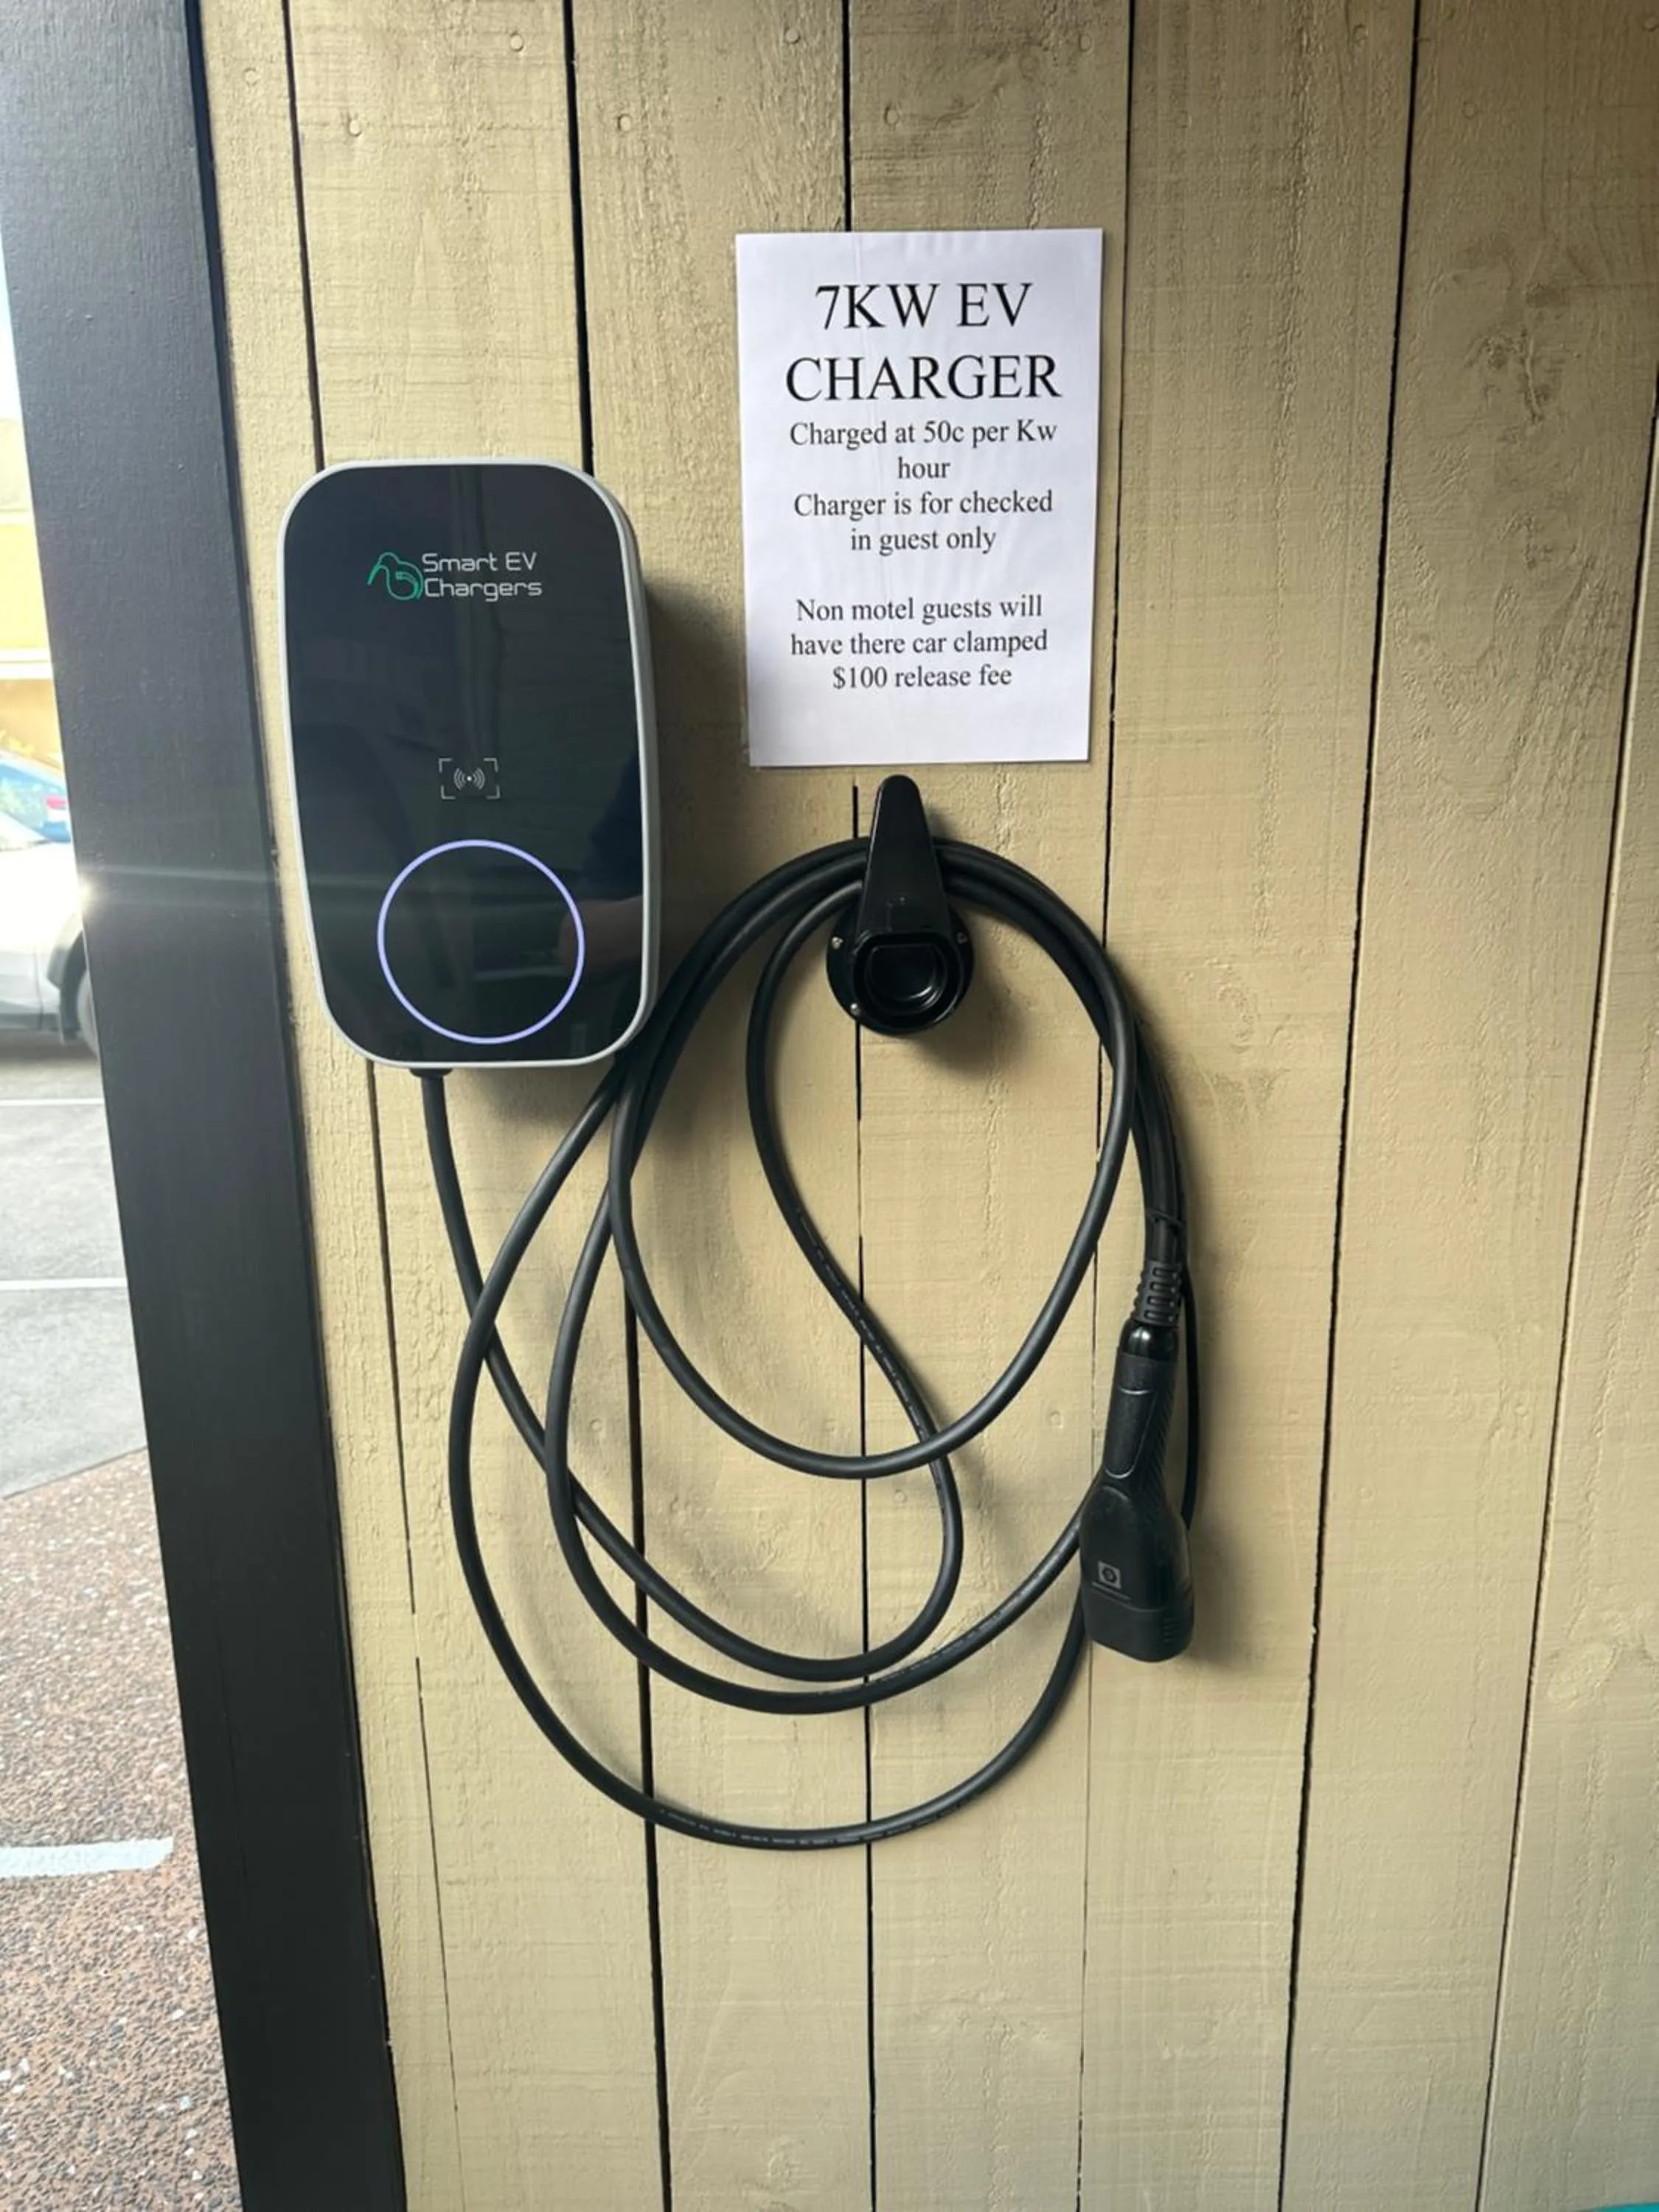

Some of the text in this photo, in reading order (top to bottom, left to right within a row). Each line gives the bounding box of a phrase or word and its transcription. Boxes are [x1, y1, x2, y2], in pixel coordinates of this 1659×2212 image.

[815, 282, 1033, 330] 7KW EV
[786, 355, 1062, 402] CHARGER
[790, 418, 1057, 451] Charged at 50c per Kw
[897, 456, 951, 479] hour
[793, 489, 1053, 522] Charger is for checked
[851, 525, 996, 557] in guest only
[421, 551, 538, 572] Smart EV
[424, 577, 543, 602] Chargers
[796, 594, 1042, 626] Non motel guests will
[790, 630, 1048, 657] have there car clamped
[832, 663, 1012, 690] $100 release fee
